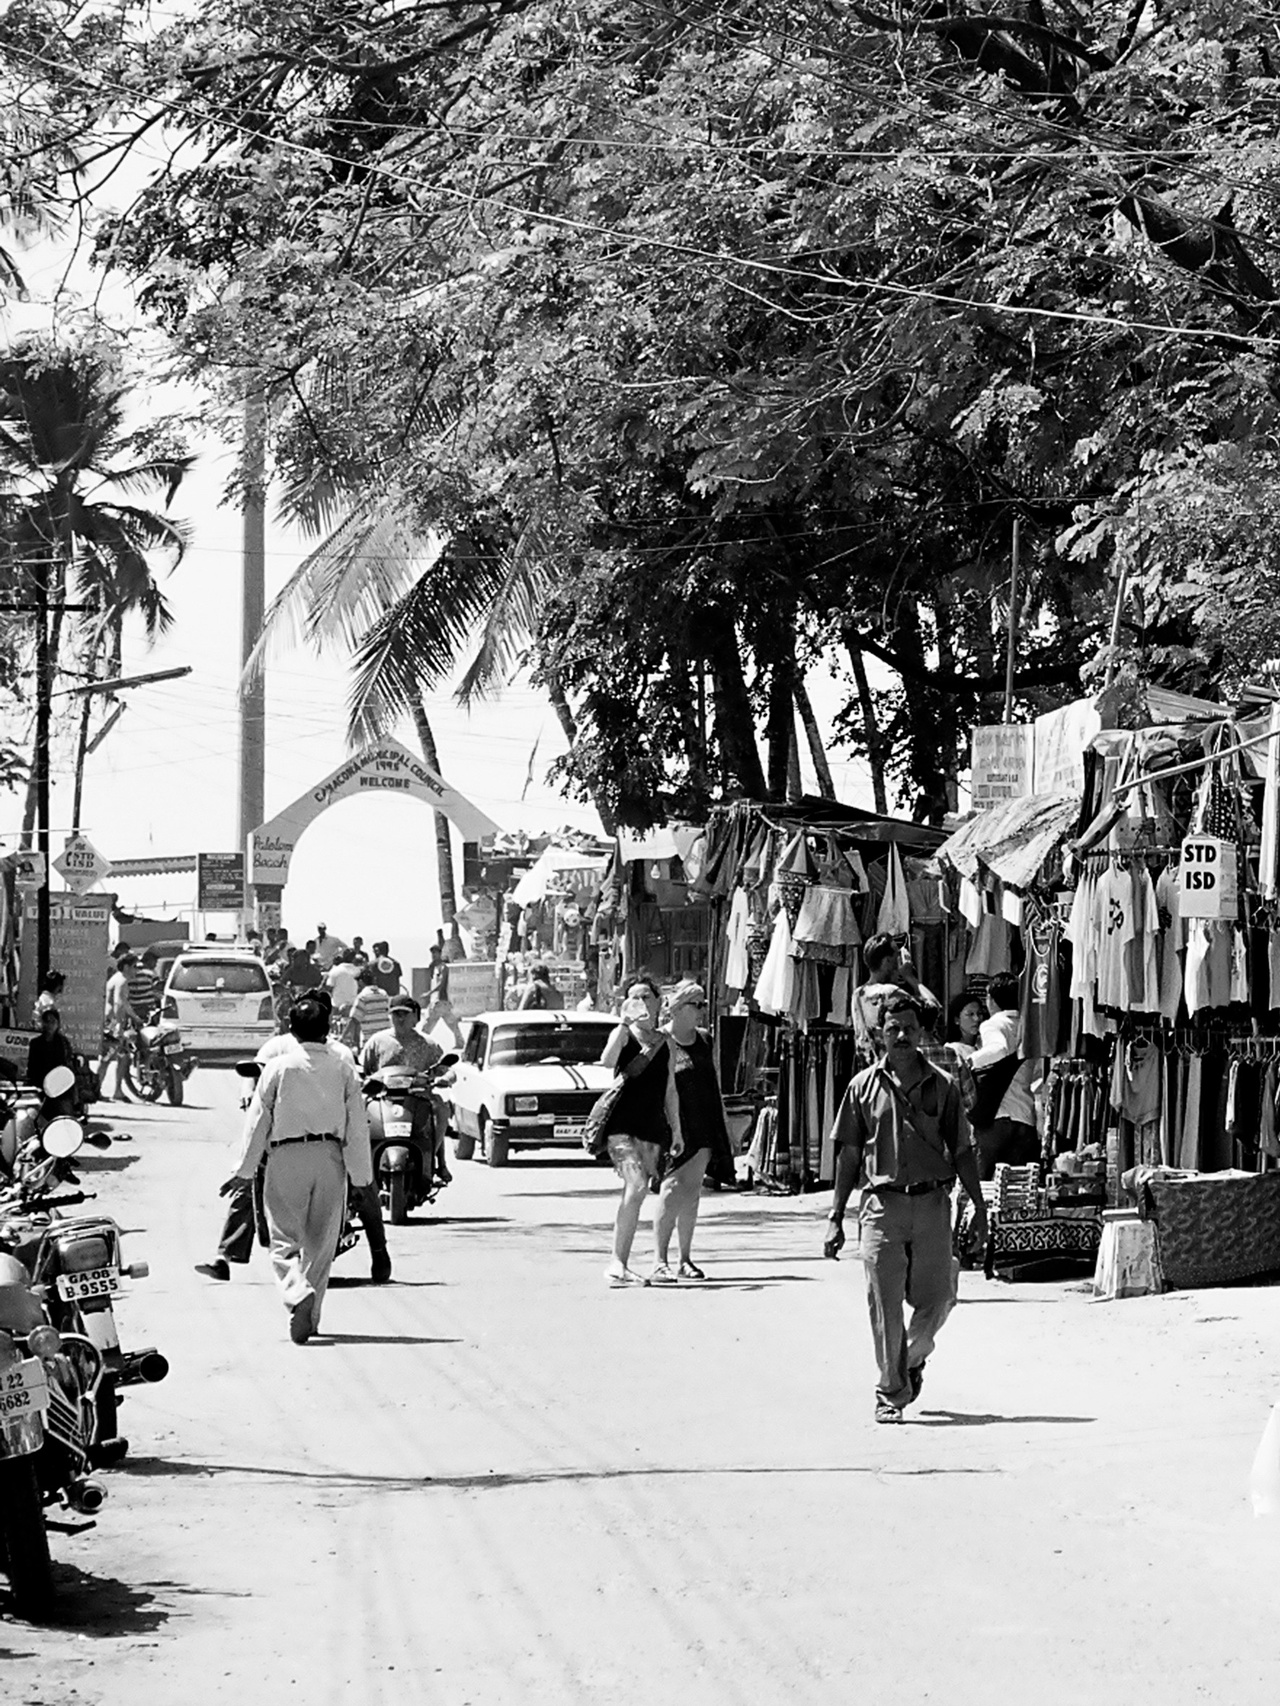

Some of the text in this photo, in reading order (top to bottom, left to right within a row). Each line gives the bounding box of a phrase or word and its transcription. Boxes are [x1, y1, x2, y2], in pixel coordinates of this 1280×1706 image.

[360, 777, 410, 788] WELCOME
[410, 763, 445, 797] COUNCIL
[73, 852, 95, 860] STD
[1184, 844, 1217, 863] STD
[73, 860, 94, 868] ISD
[1186, 871, 1216, 890] ISD
[6, 1373, 24, 1389] 22
